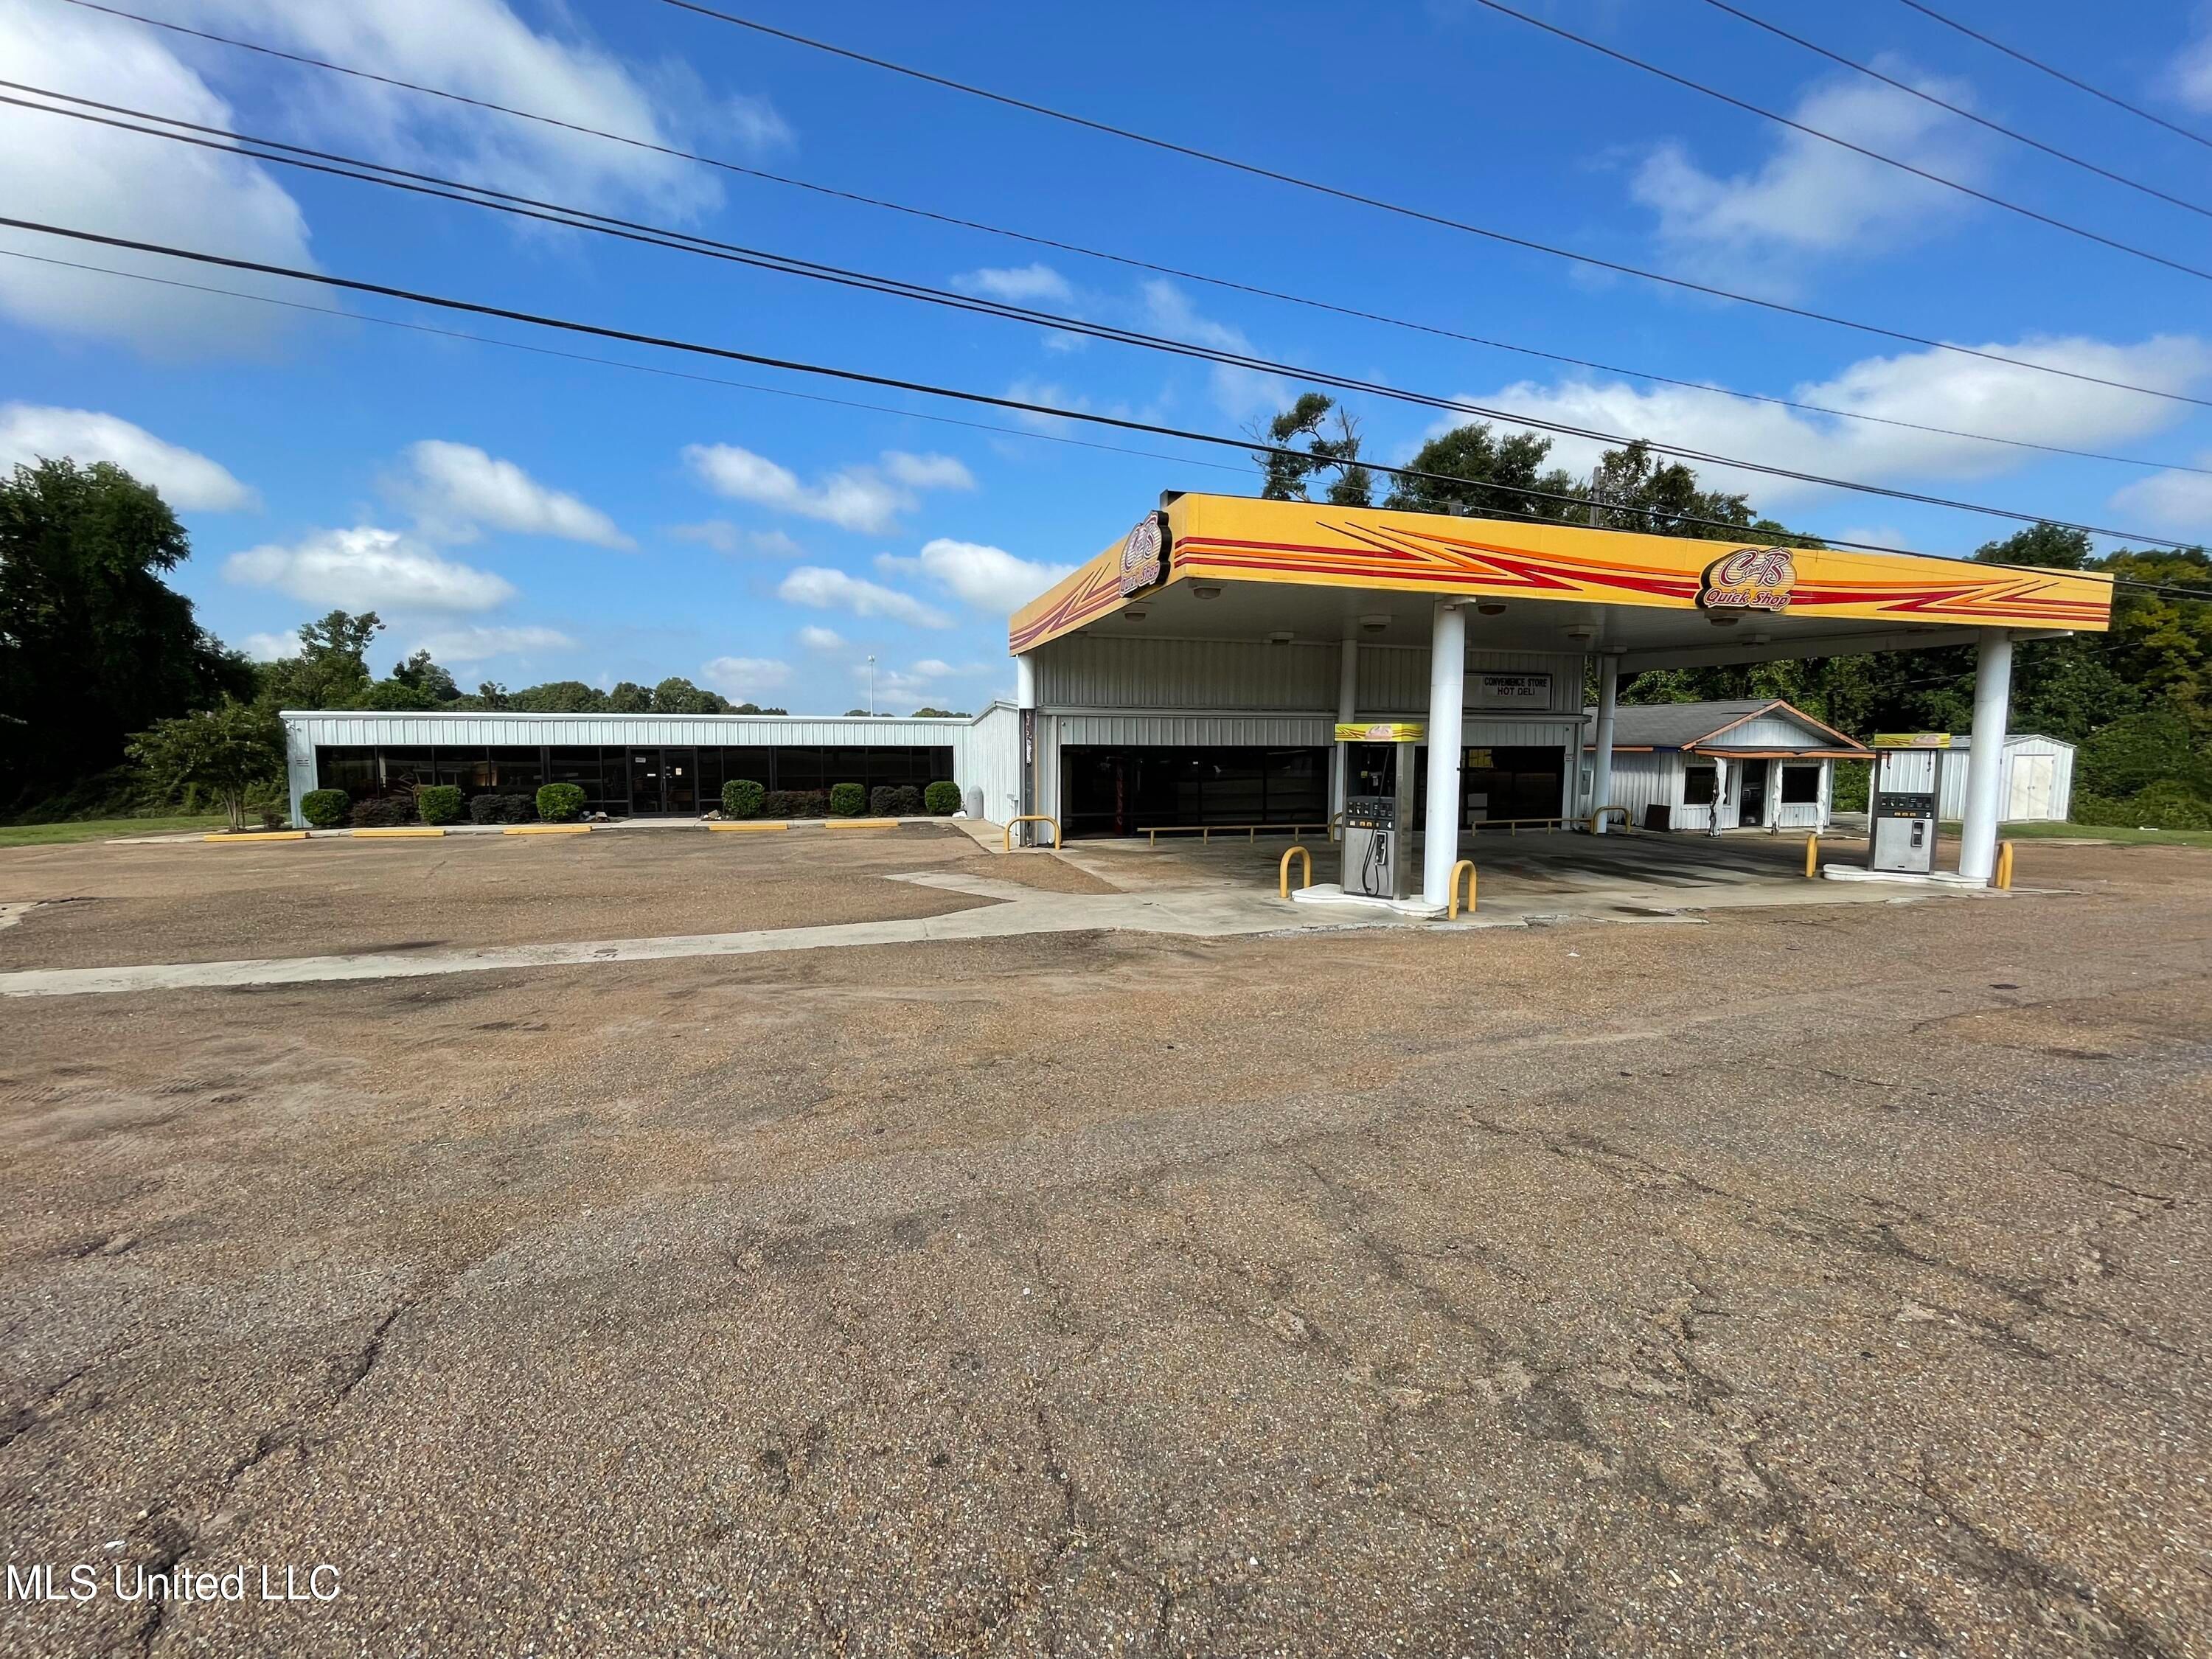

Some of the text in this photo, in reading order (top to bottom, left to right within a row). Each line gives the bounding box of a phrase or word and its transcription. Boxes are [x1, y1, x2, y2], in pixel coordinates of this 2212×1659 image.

[1705, 590, 1789, 608] Quick Shop
[1484, 677, 1547, 687] CONVENIENCE STORE
[1498, 686, 1535, 695] HOT DELI
